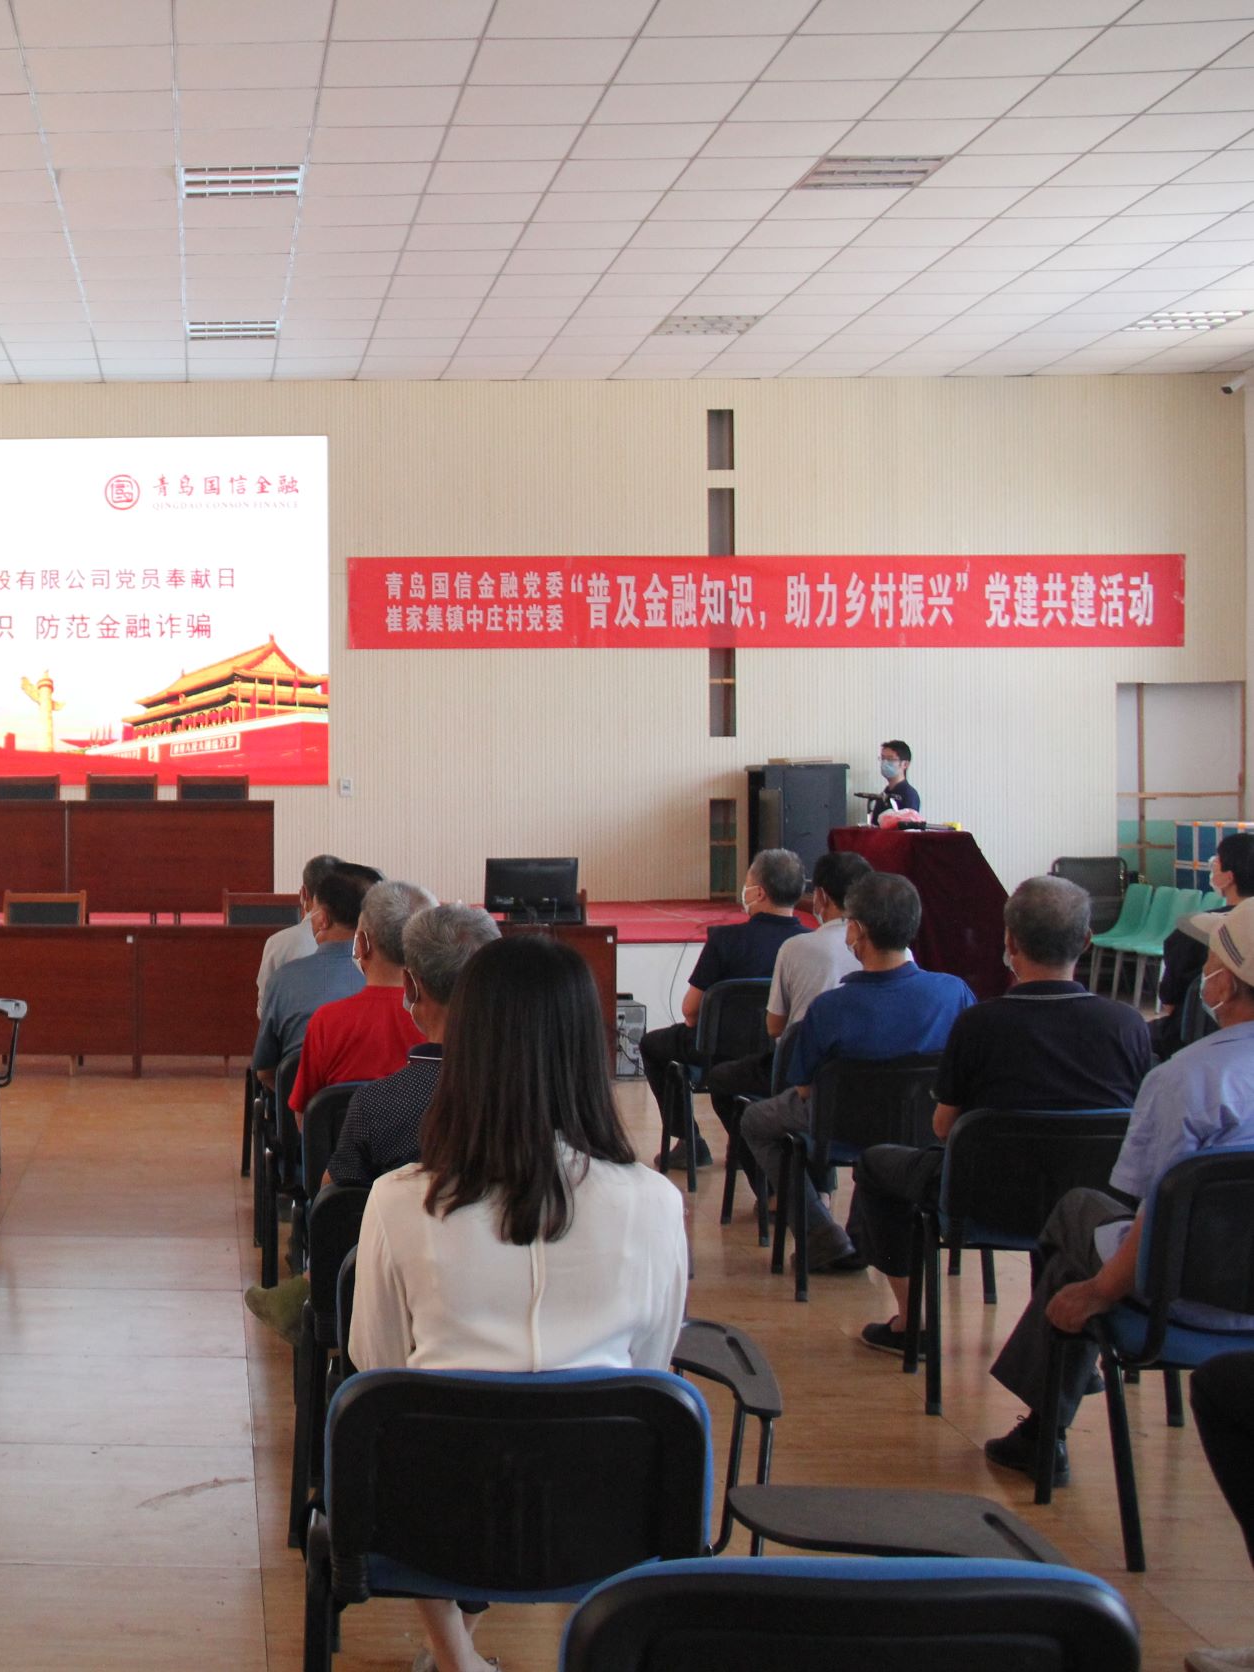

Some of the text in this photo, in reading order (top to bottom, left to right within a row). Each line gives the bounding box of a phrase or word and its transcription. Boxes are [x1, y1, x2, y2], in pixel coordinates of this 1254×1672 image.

[153, 474, 299, 496] 青岛国信金融
[385, 571, 564, 599] 青岛国信金融党委
[36, 613, 211, 639] 防范金融诈骗
[385, 605, 564, 632] 崔家集镇中庄村党委
